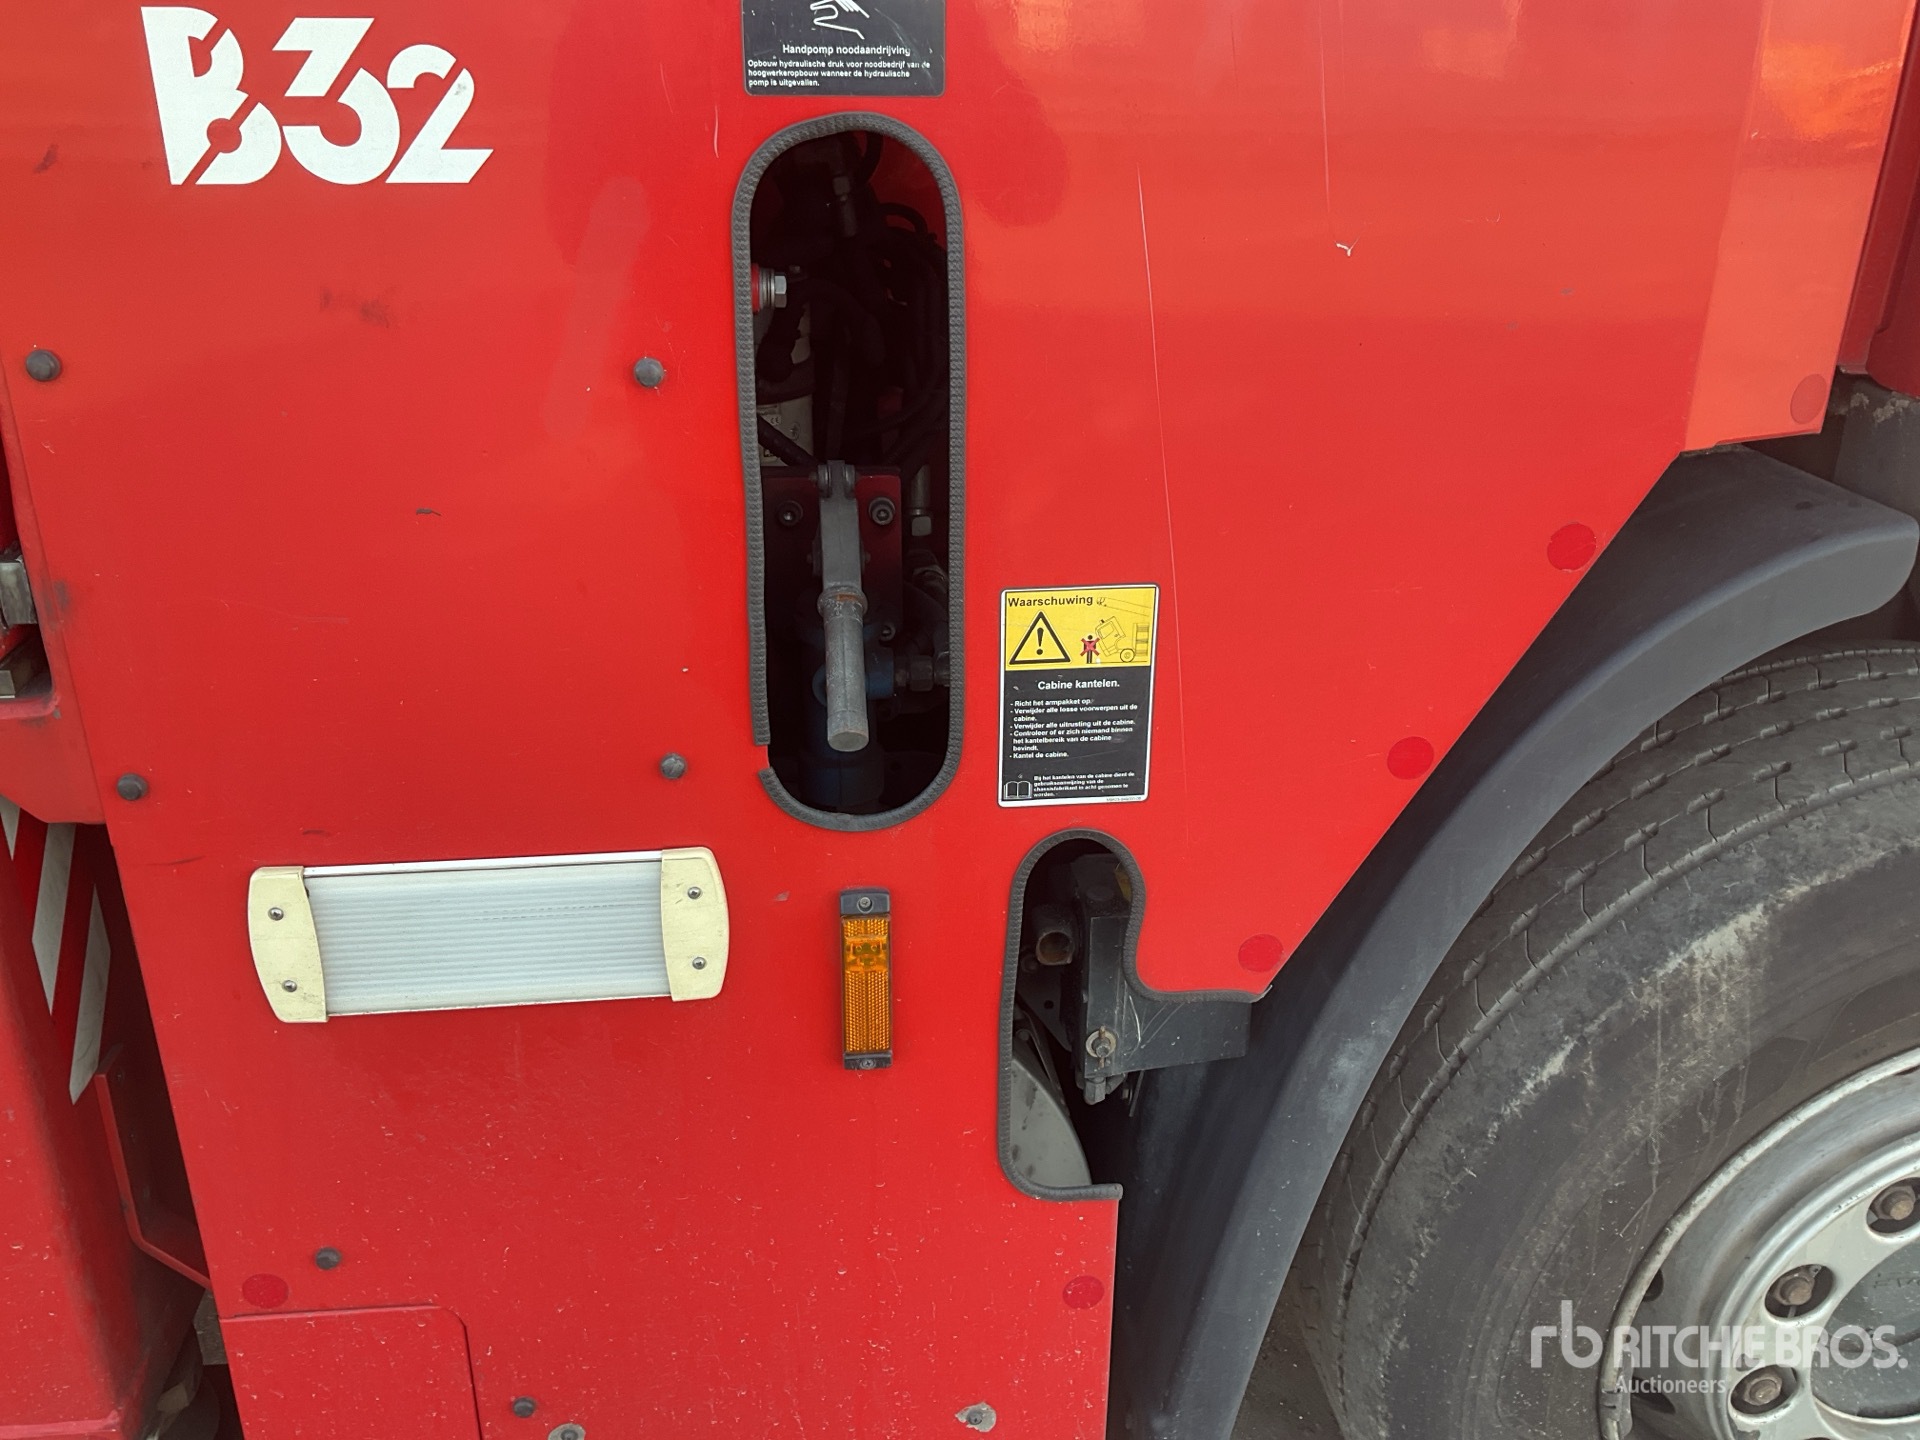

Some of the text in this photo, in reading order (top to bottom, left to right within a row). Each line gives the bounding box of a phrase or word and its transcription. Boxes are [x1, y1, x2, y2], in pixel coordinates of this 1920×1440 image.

[782, 44, 911, 57] Handpomp noodaandrijving
[747, 60, 778, 69] Opbouw
[779, 60, 826, 69] hydraulische
[827, 60, 844, 68] druk
[864, 60, 905, 69] noodbedrijf
[906, 61, 920, 69] van
[747, 69, 819, 78] hoogwerkeropbouw
[853, 69, 862, 77] de
[863, 69, 910, 78] hydraulische
[748, 79, 820, 88] pomp is uitgevallen.
[140, 6, 494, 185] B32
[1008, 595, 1093, 607] Waarschuwing
[1037, 678, 1120, 690] Cabine kantelen.
[1014, 707, 1046, 715] Verwijder
[1079, 704, 1119, 712] voorwerpen
[1013, 722, 1045, 730] Verwijder
[1059, 720, 1092, 728] uitrusting
[1013, 729, 1049, 737] Controleer
[1024, 736, 1065, 744] kantelbereik
[1012, 744, 1039, 752] bevindt.
[1044, 750, 1070, 758] cabine.
